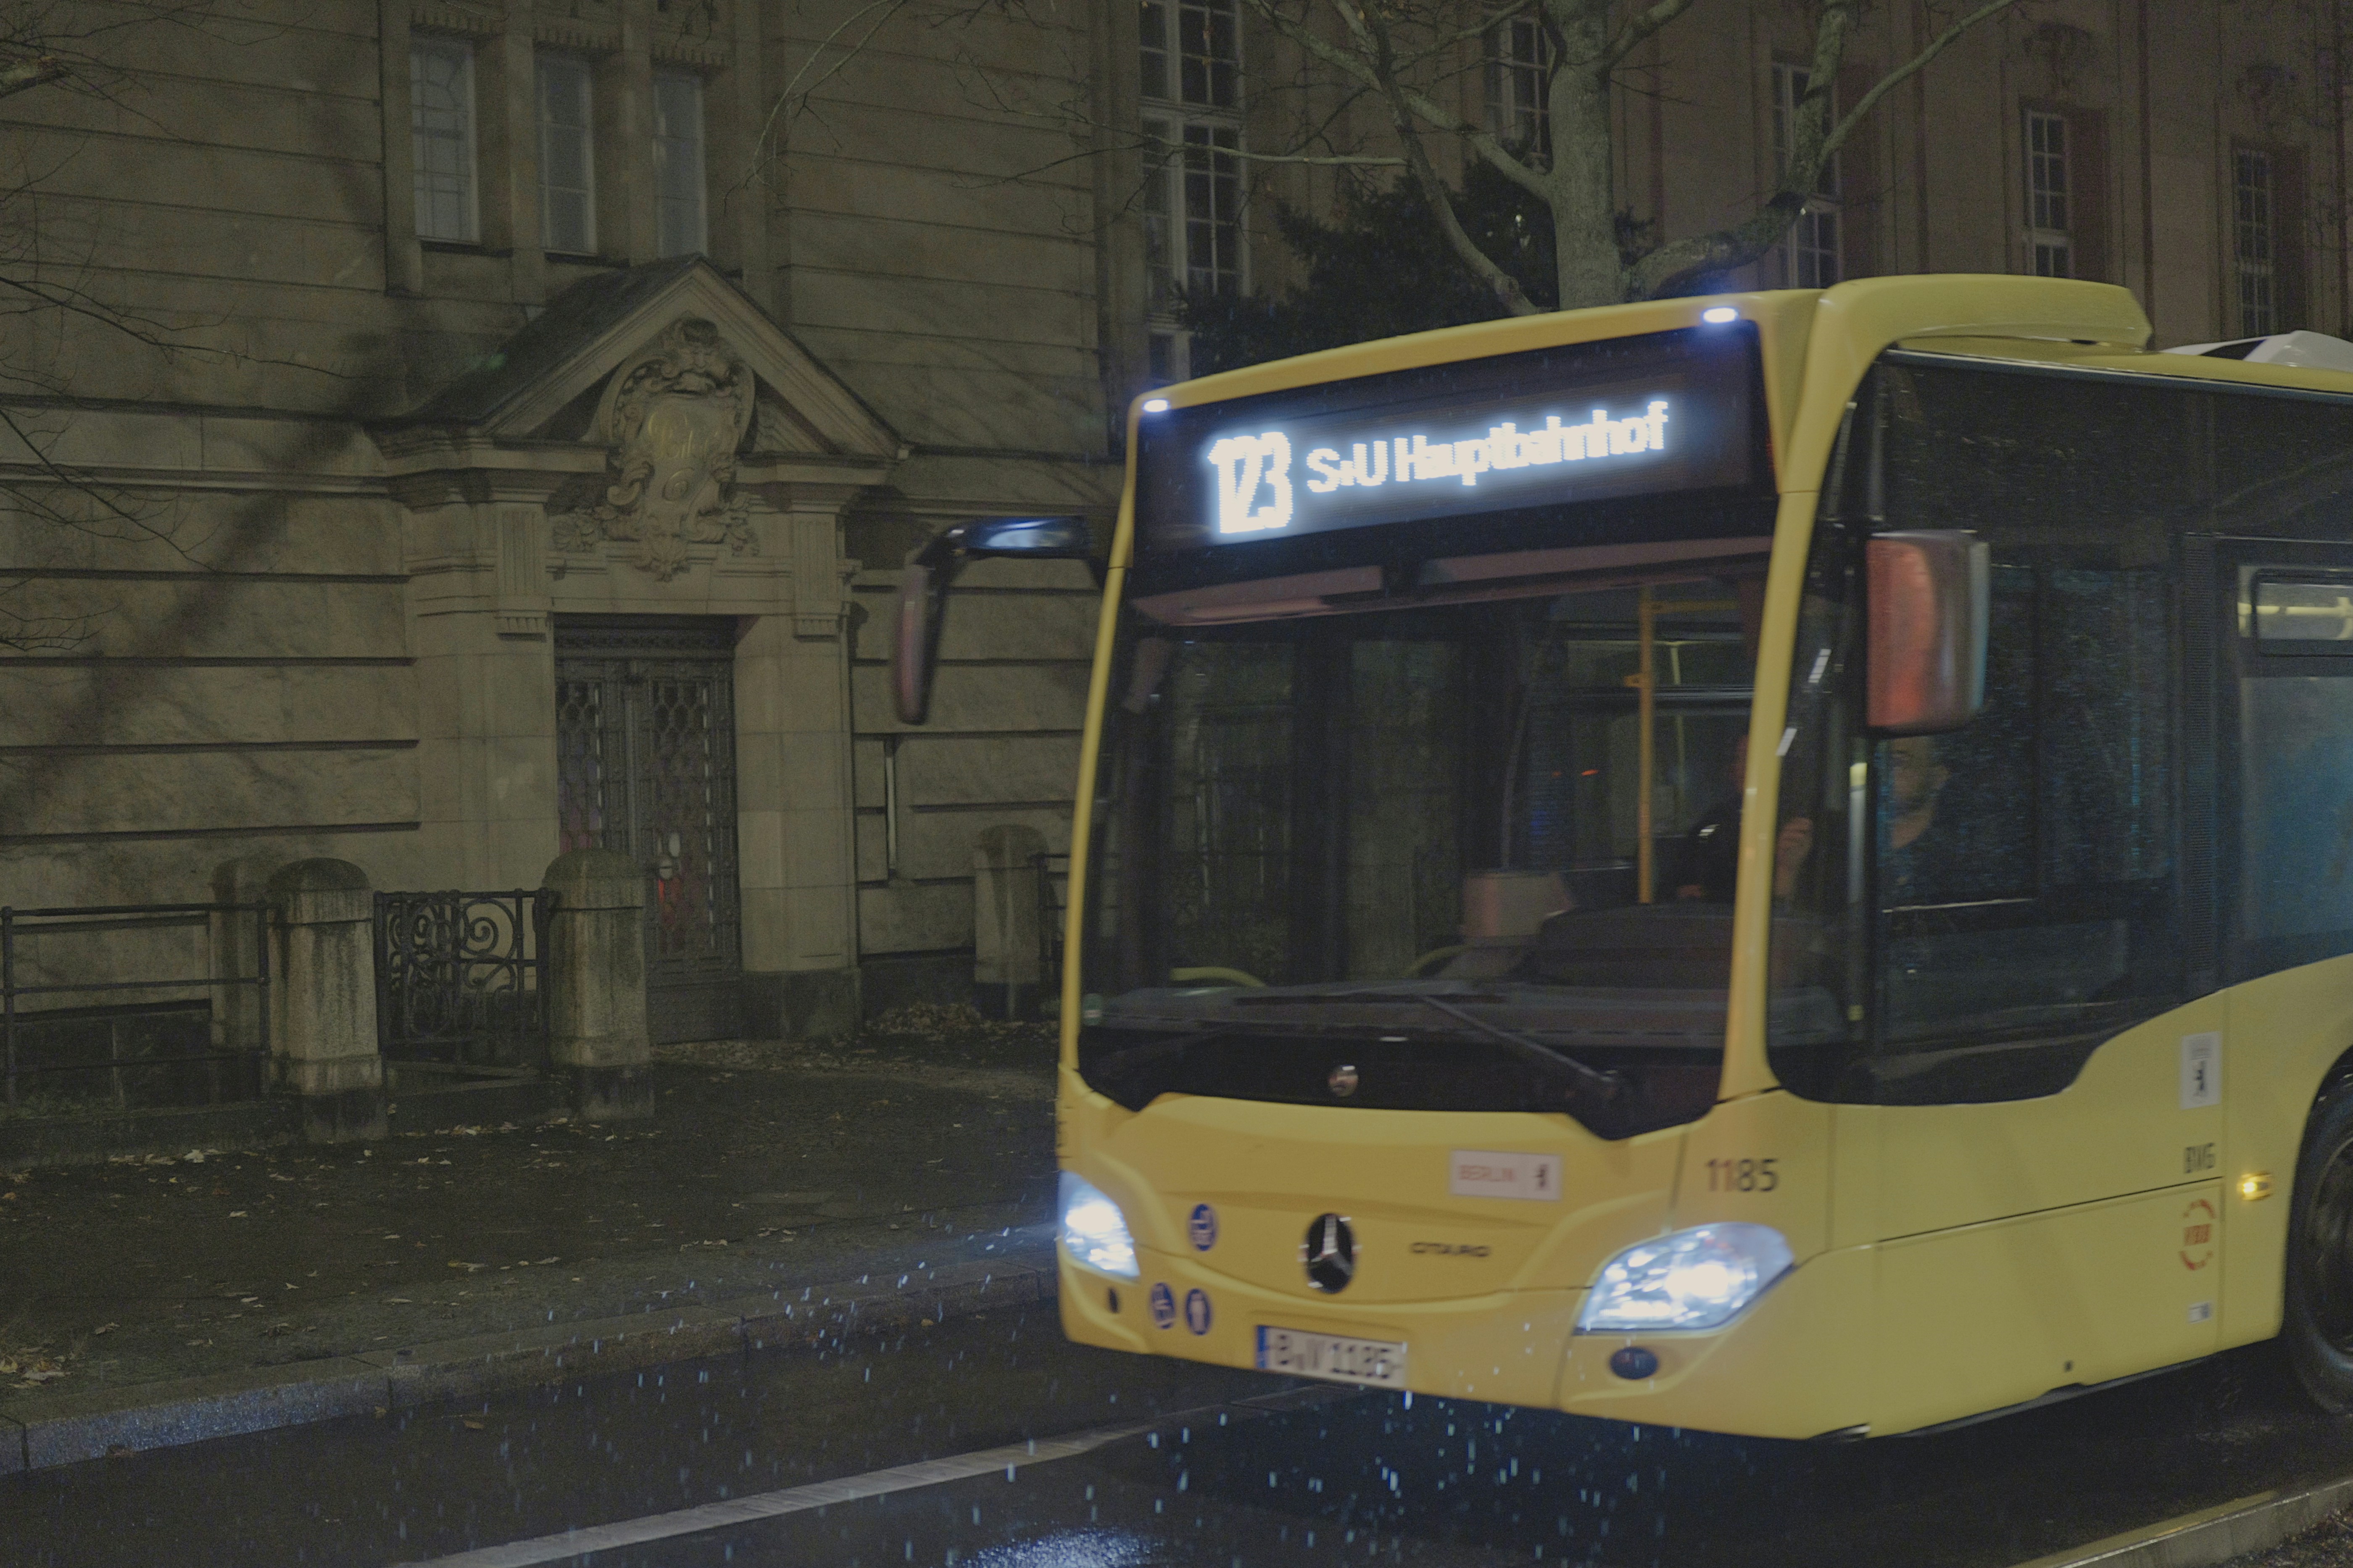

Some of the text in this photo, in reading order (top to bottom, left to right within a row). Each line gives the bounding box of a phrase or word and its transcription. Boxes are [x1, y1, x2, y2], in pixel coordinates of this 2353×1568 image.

[1207, 431, 1294, 534] 123
[1394, 400, 1669, 486] Hauptbahnhof
[1706, 1158, 1779, 1192] 1185
